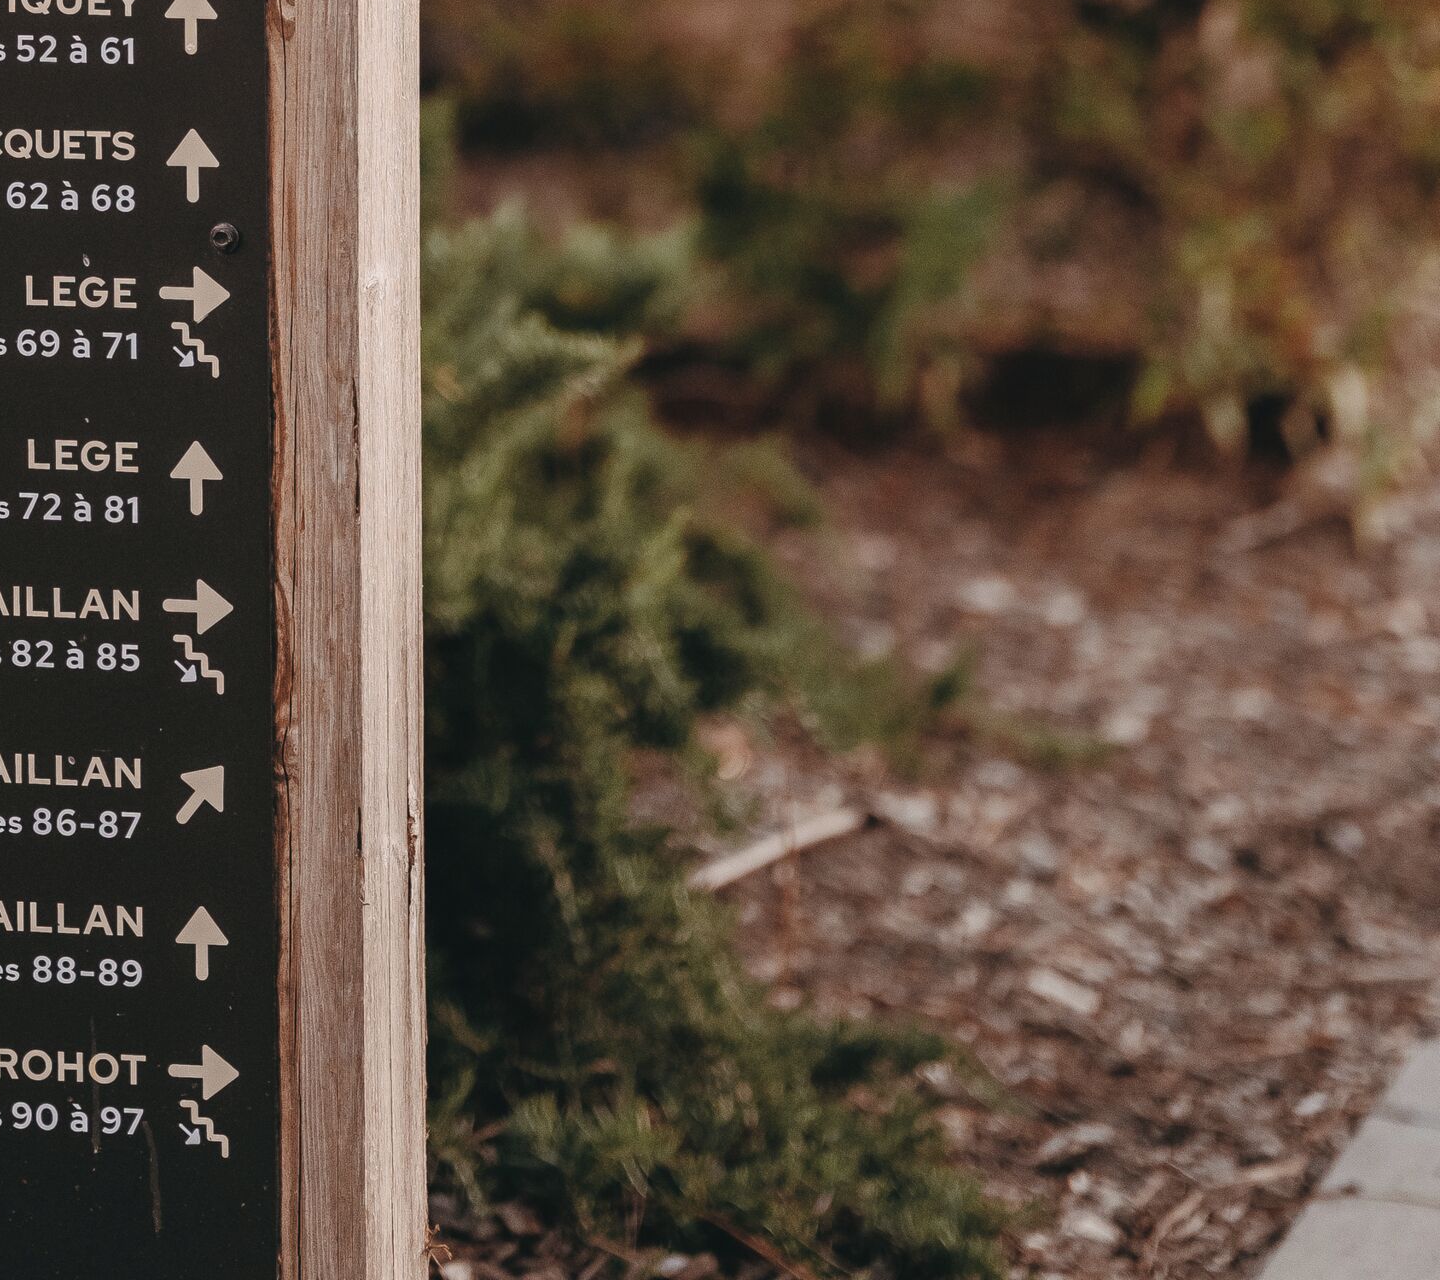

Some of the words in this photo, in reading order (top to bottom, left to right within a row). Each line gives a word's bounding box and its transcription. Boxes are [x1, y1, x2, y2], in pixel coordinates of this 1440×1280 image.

[16, 34, 58, 63] 52
[69, 34, 88, 64] à
[100, 36, 135, 65] 61
[6, 181, 49, 210] 62
[60, 180, 79, 211] à
[91, 183, 136, 213] 68
[25, 274, 138, 309] LEGE
[15, 328, 60, 358] 69
[72, 328, 91, 359] à
[102, 331, 138, 360] 71
[27, 438, 139, 474] LEGE
[18, 491, 62, 521] 72
[73, 492, 92, 523] à
[104, 495, 139, 524] 81
[11, 639, 55, 669] 82
[65, 640, 85, 670] à
[96, 642, 140, 672] 85
[32, 807, 142, 839] 86-87
[32, 955, 143, 988] 88-89
[11, 1101, 59, 1131] 90
[70, 1103, 89, 1133] à
[100, 1106, 144, 1135] 97
